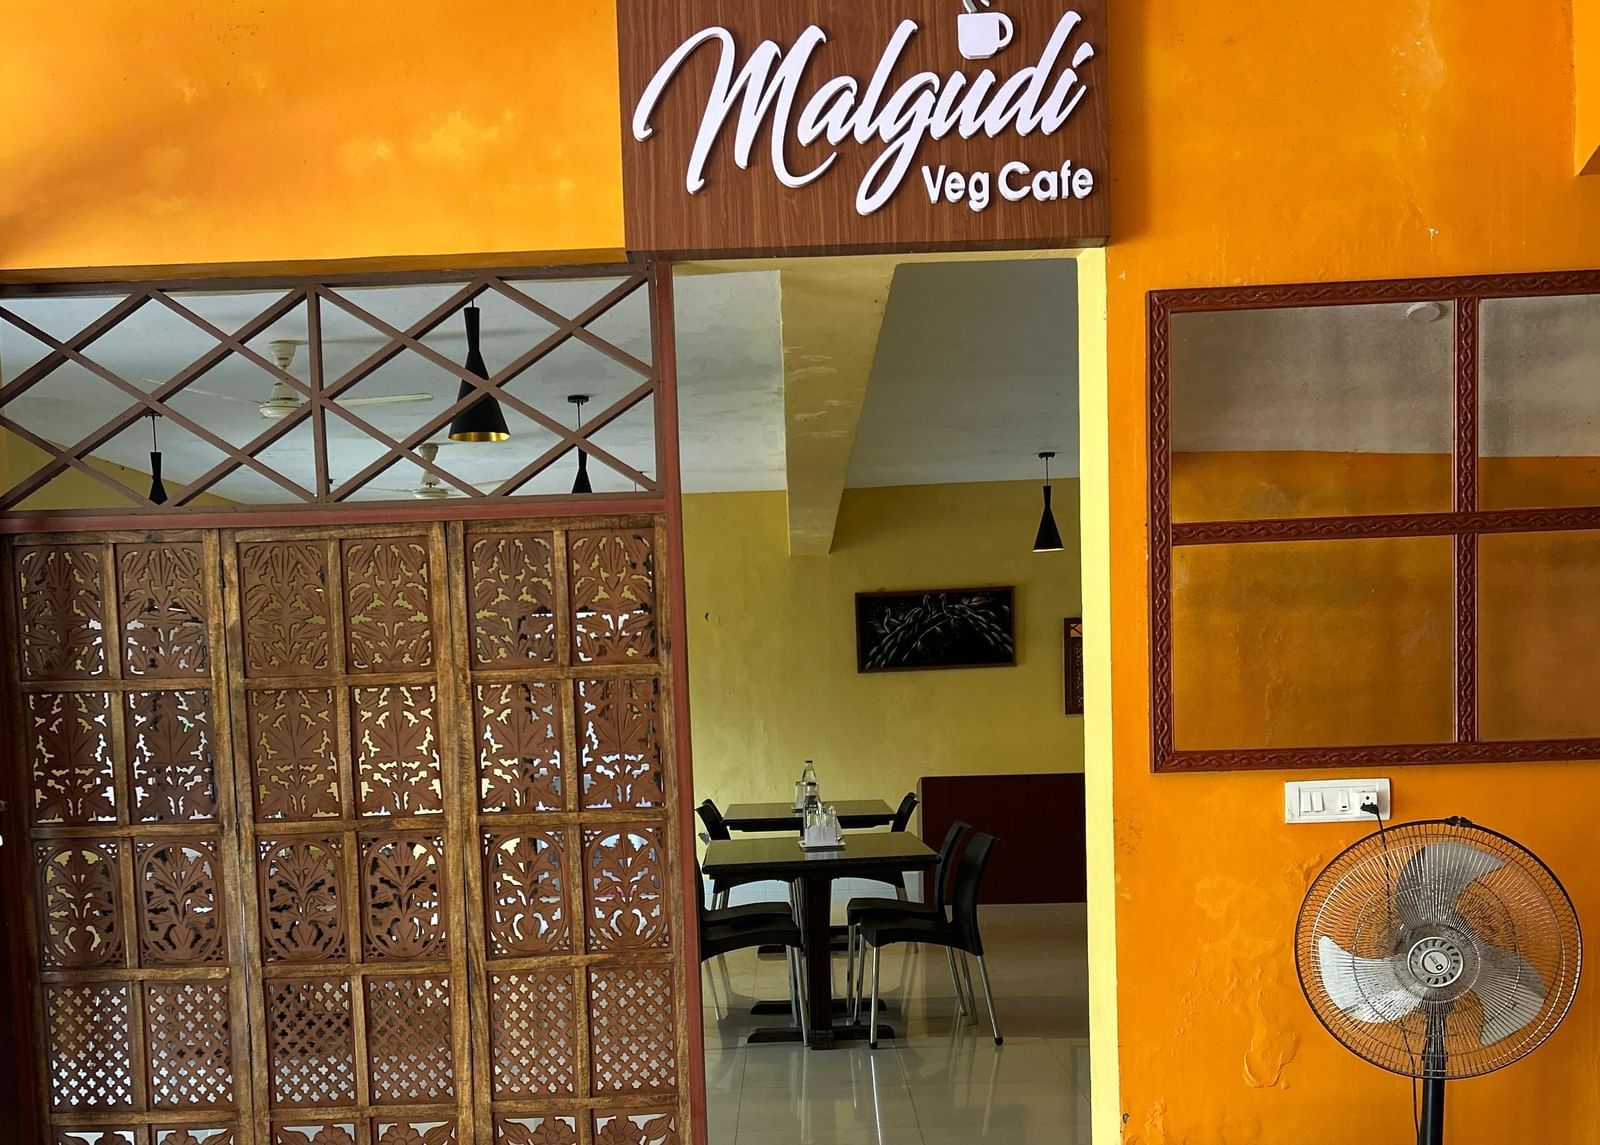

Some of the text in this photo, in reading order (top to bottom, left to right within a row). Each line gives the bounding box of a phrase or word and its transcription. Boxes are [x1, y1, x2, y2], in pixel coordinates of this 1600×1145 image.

[632, 10, 1094, 216] Malgudi
[921, 159, 1095, 212] Veg Cafe
